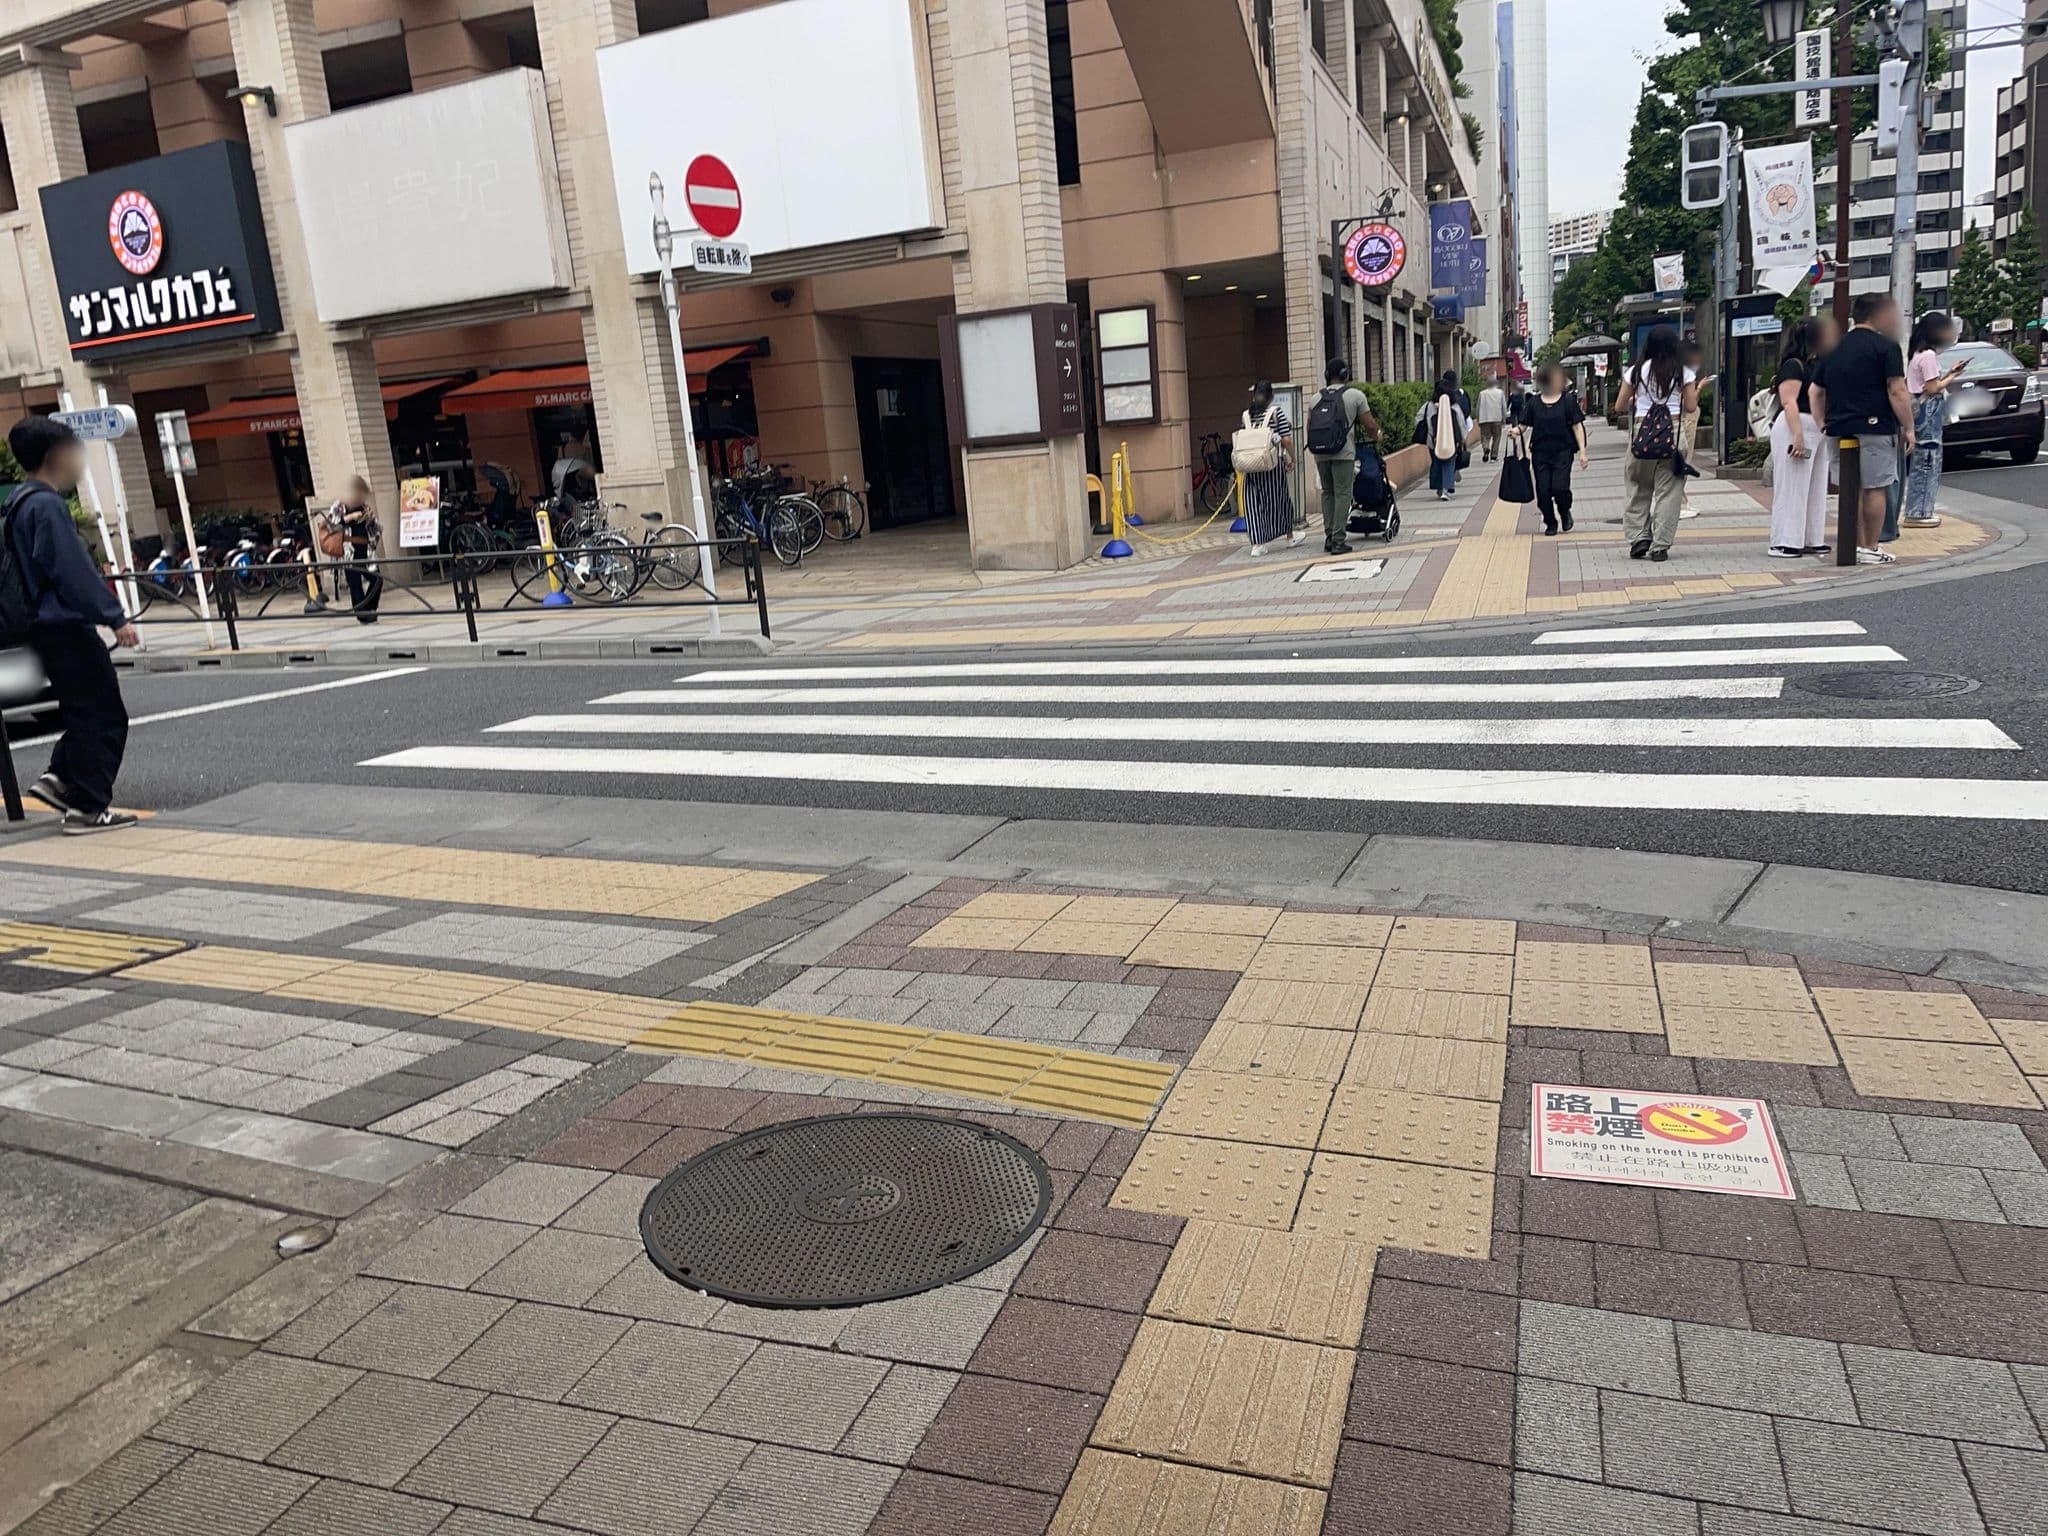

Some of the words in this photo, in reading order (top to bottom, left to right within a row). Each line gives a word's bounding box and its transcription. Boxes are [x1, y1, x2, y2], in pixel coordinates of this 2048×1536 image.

[1806, 35, 1820, 120] 国技館通商店会
[696, 246, 748, 266] 自転車を除く
[69, 266, 236, 337] サンマルクカフェ
[535, 391, 579, 404] ST.MARC
[250, 417, 288, 431] ST.MARC
[1546, 1092, 1642, 1117] 路上
[1656, 1102, 1717, 1113] SUMIDA
[1546, 1112, 1645, 1139] 禁煙
[1547, 1137, 1597, 1150] Smoking
[1621, 1143, 1640, 1152] the
[1645, 1146, 1682, 1156] street
[1687, 1149, 1697, 1157] is
[1702, 1150, 1769, 1166] prohibited
